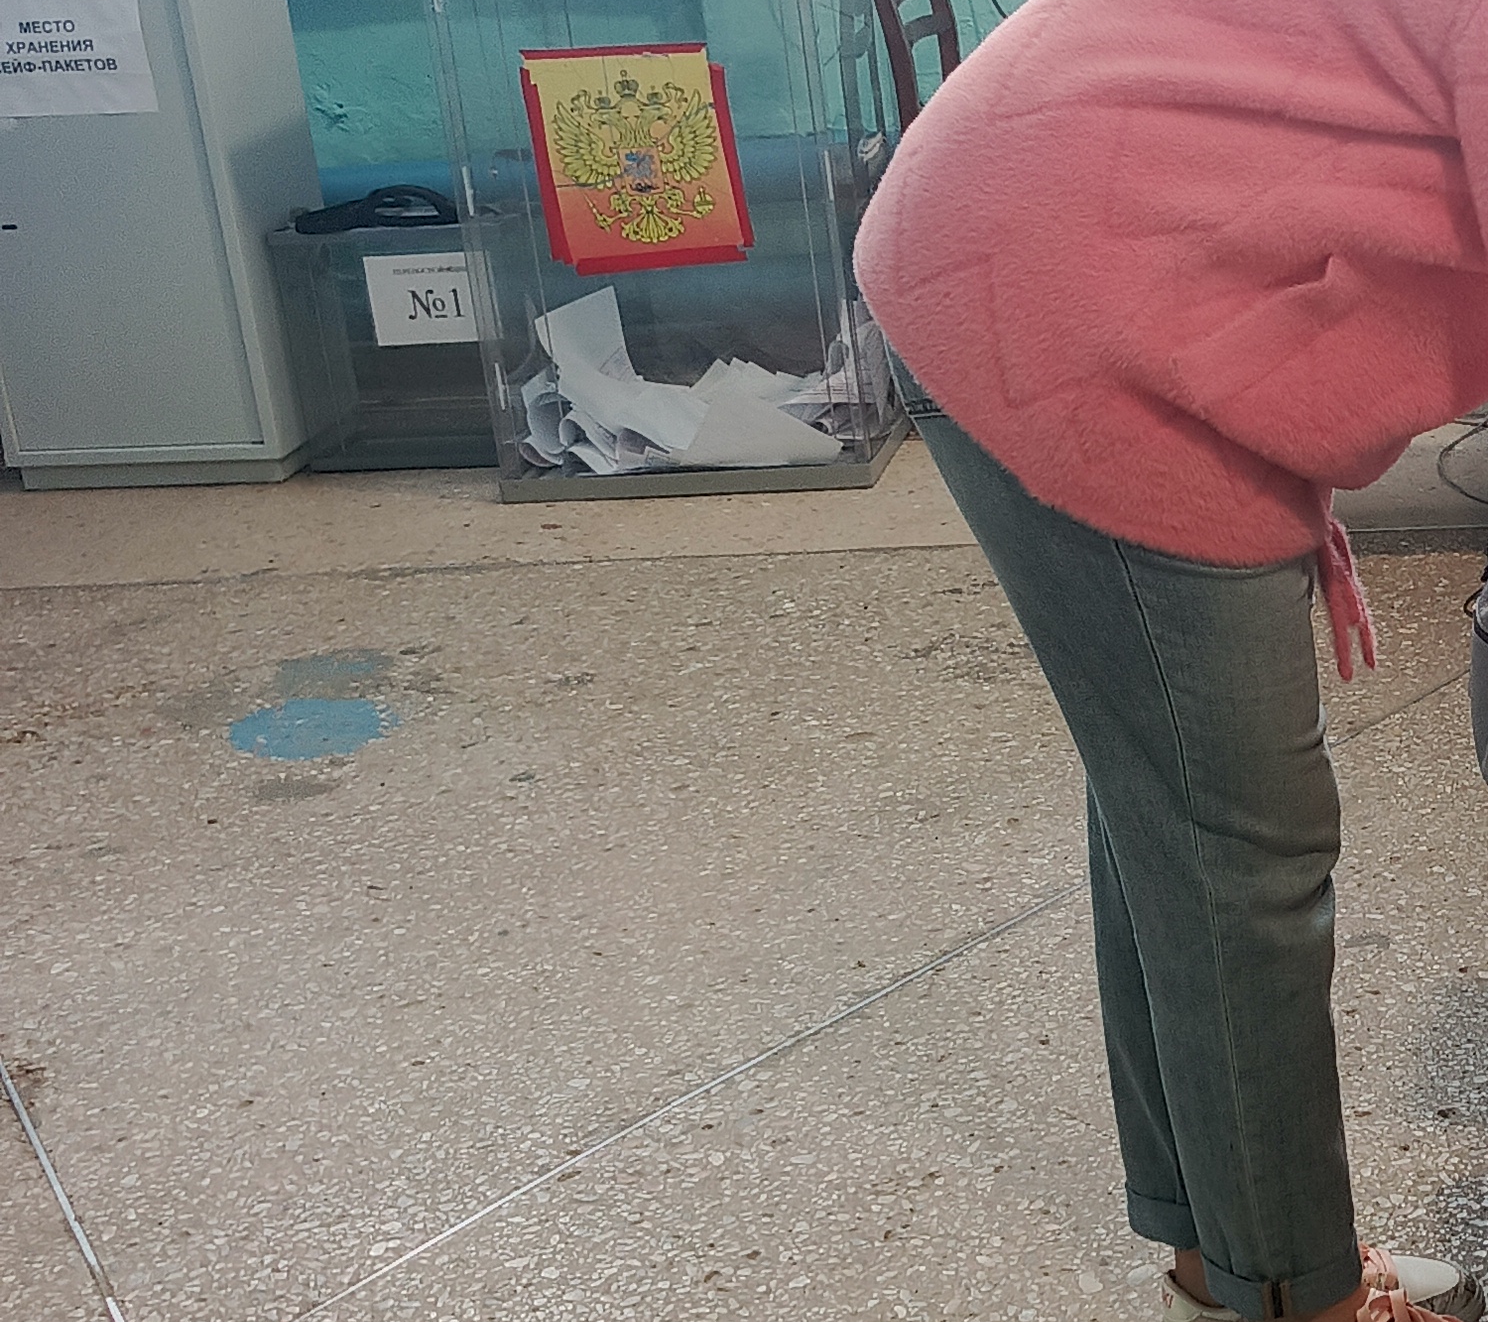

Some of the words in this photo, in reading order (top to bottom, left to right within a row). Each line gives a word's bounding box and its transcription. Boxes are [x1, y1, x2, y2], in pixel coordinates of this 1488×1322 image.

[19, 20, 75, 33] МЕСТО
[6, 39, 94, 54] ХРАНЕНИЯ
[0, 58, 118, 74] ЕЙФ-ПАКЕТОВ
